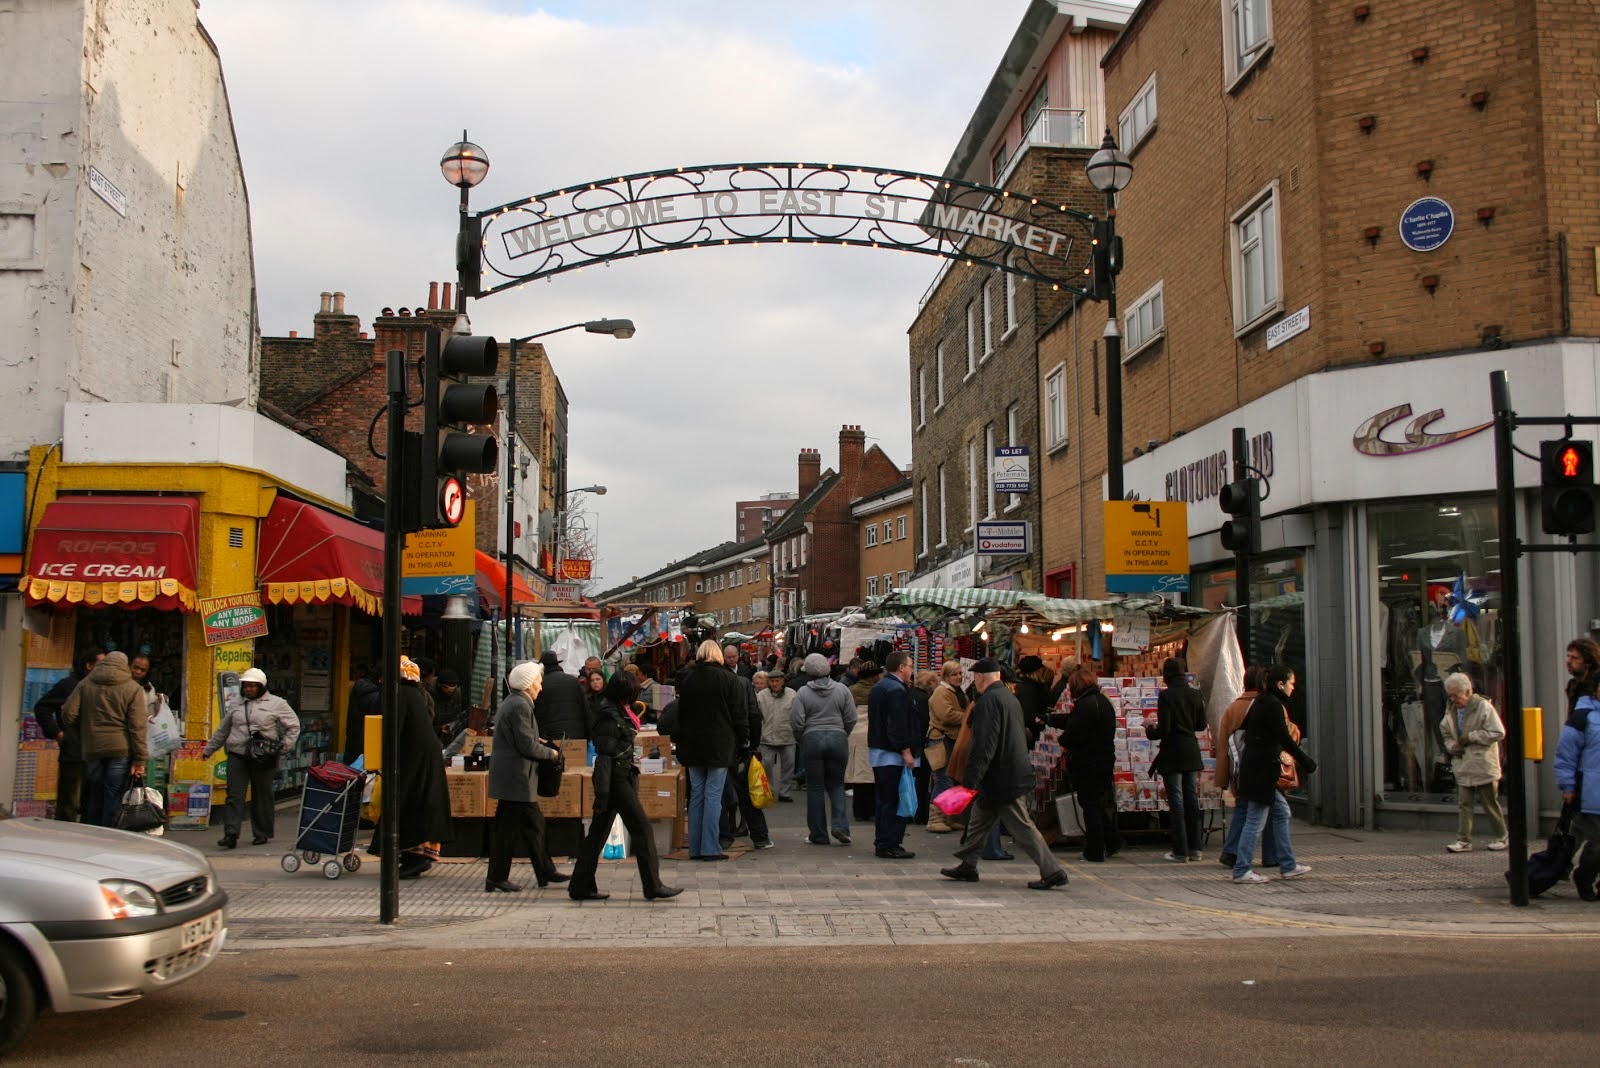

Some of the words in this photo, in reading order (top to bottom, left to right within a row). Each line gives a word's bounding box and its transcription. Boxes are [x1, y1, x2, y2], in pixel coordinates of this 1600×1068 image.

[510, 196, 677, 254] WELCOME
[693, 191, 738, 217] TO
[759, 189, 843, 215] EAST
[932, 203, 1067, 256] MARKET
[1267, 325, 1281, 342] EAST
[1281, 312, 1302, 333] STREET
[414, 530, 447, 538] WARNING
[415, 551, 455, 559] OPERATION
[38, 563, 77, 577] ICE
[83, 563, 166, 579] CREAM
[202, 599, 228, 616] UNLOCK
[228, 595, 242, 606] YOUR
[217, 610, 233, 620] ANY
[234, 607, 253, 616] MAKE
[211, 619, 231, 628] ANY
[232, 614, 258, 626] MODEL
[207, 624, 265, 643] WHILE-U-WAIT
[215, 646, 251, 665] Repairs
